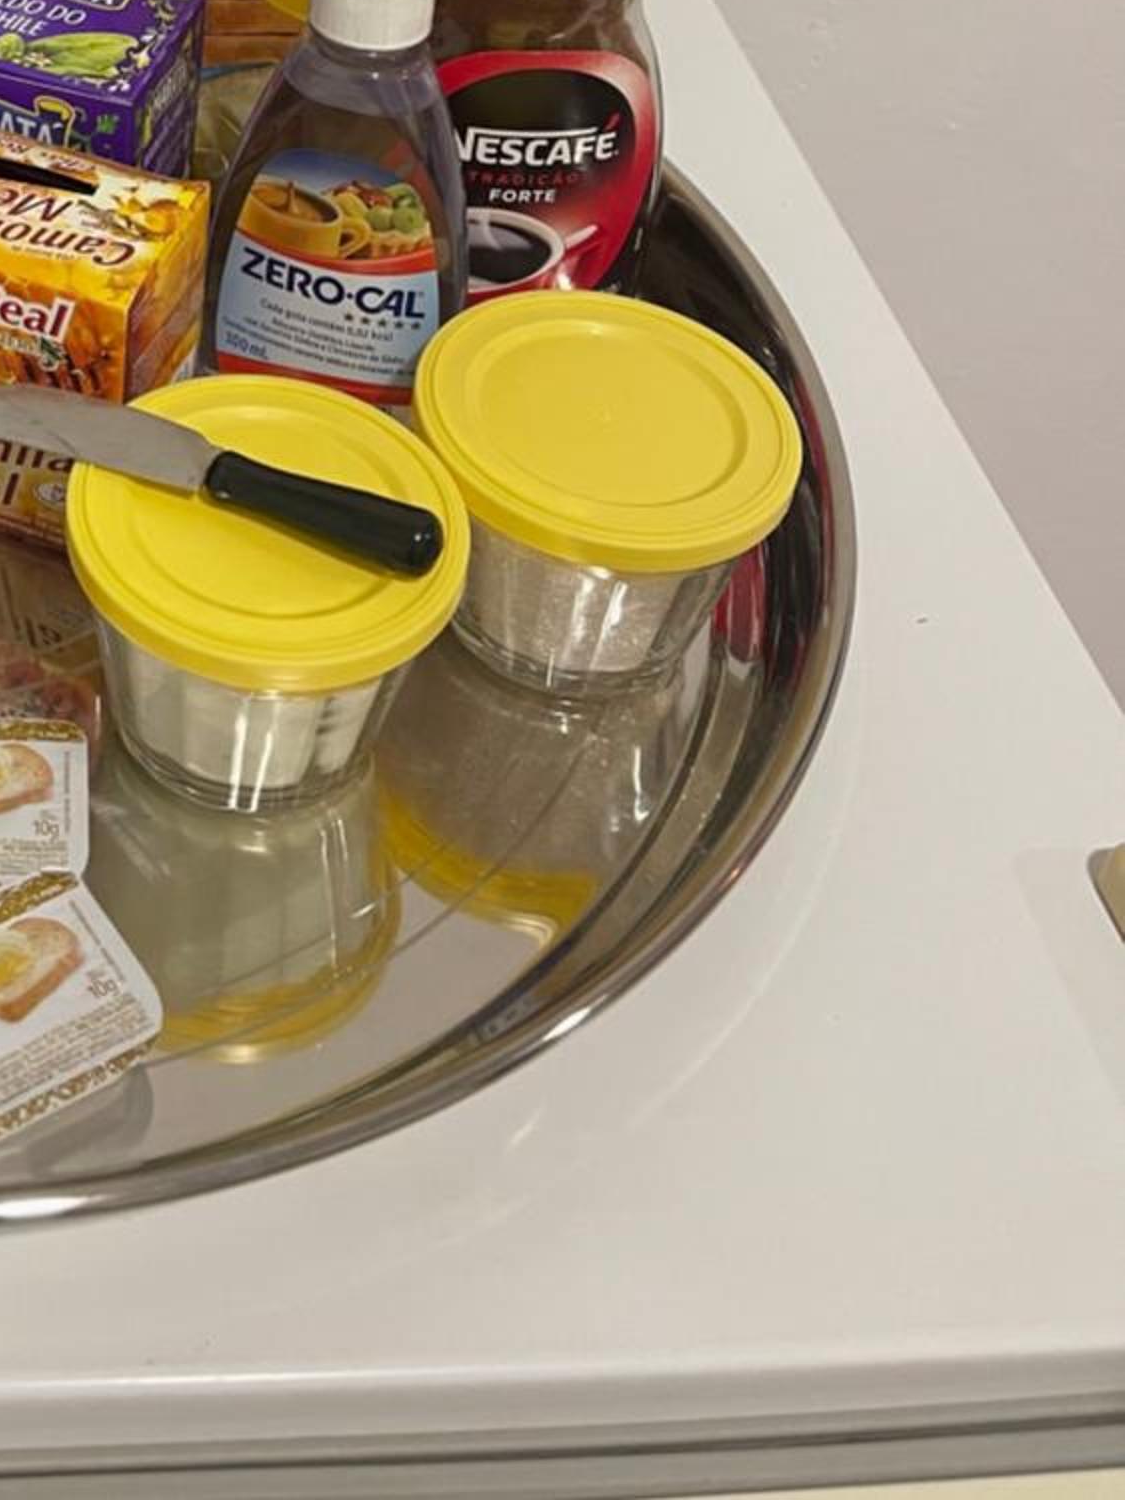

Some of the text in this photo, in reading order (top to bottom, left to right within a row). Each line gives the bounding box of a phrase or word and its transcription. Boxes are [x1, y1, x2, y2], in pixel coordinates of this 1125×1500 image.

[47, 2, 88, 26] DO
[488, 188, 556, 204] FORTE
[33, 818, 60, 843] 10g
